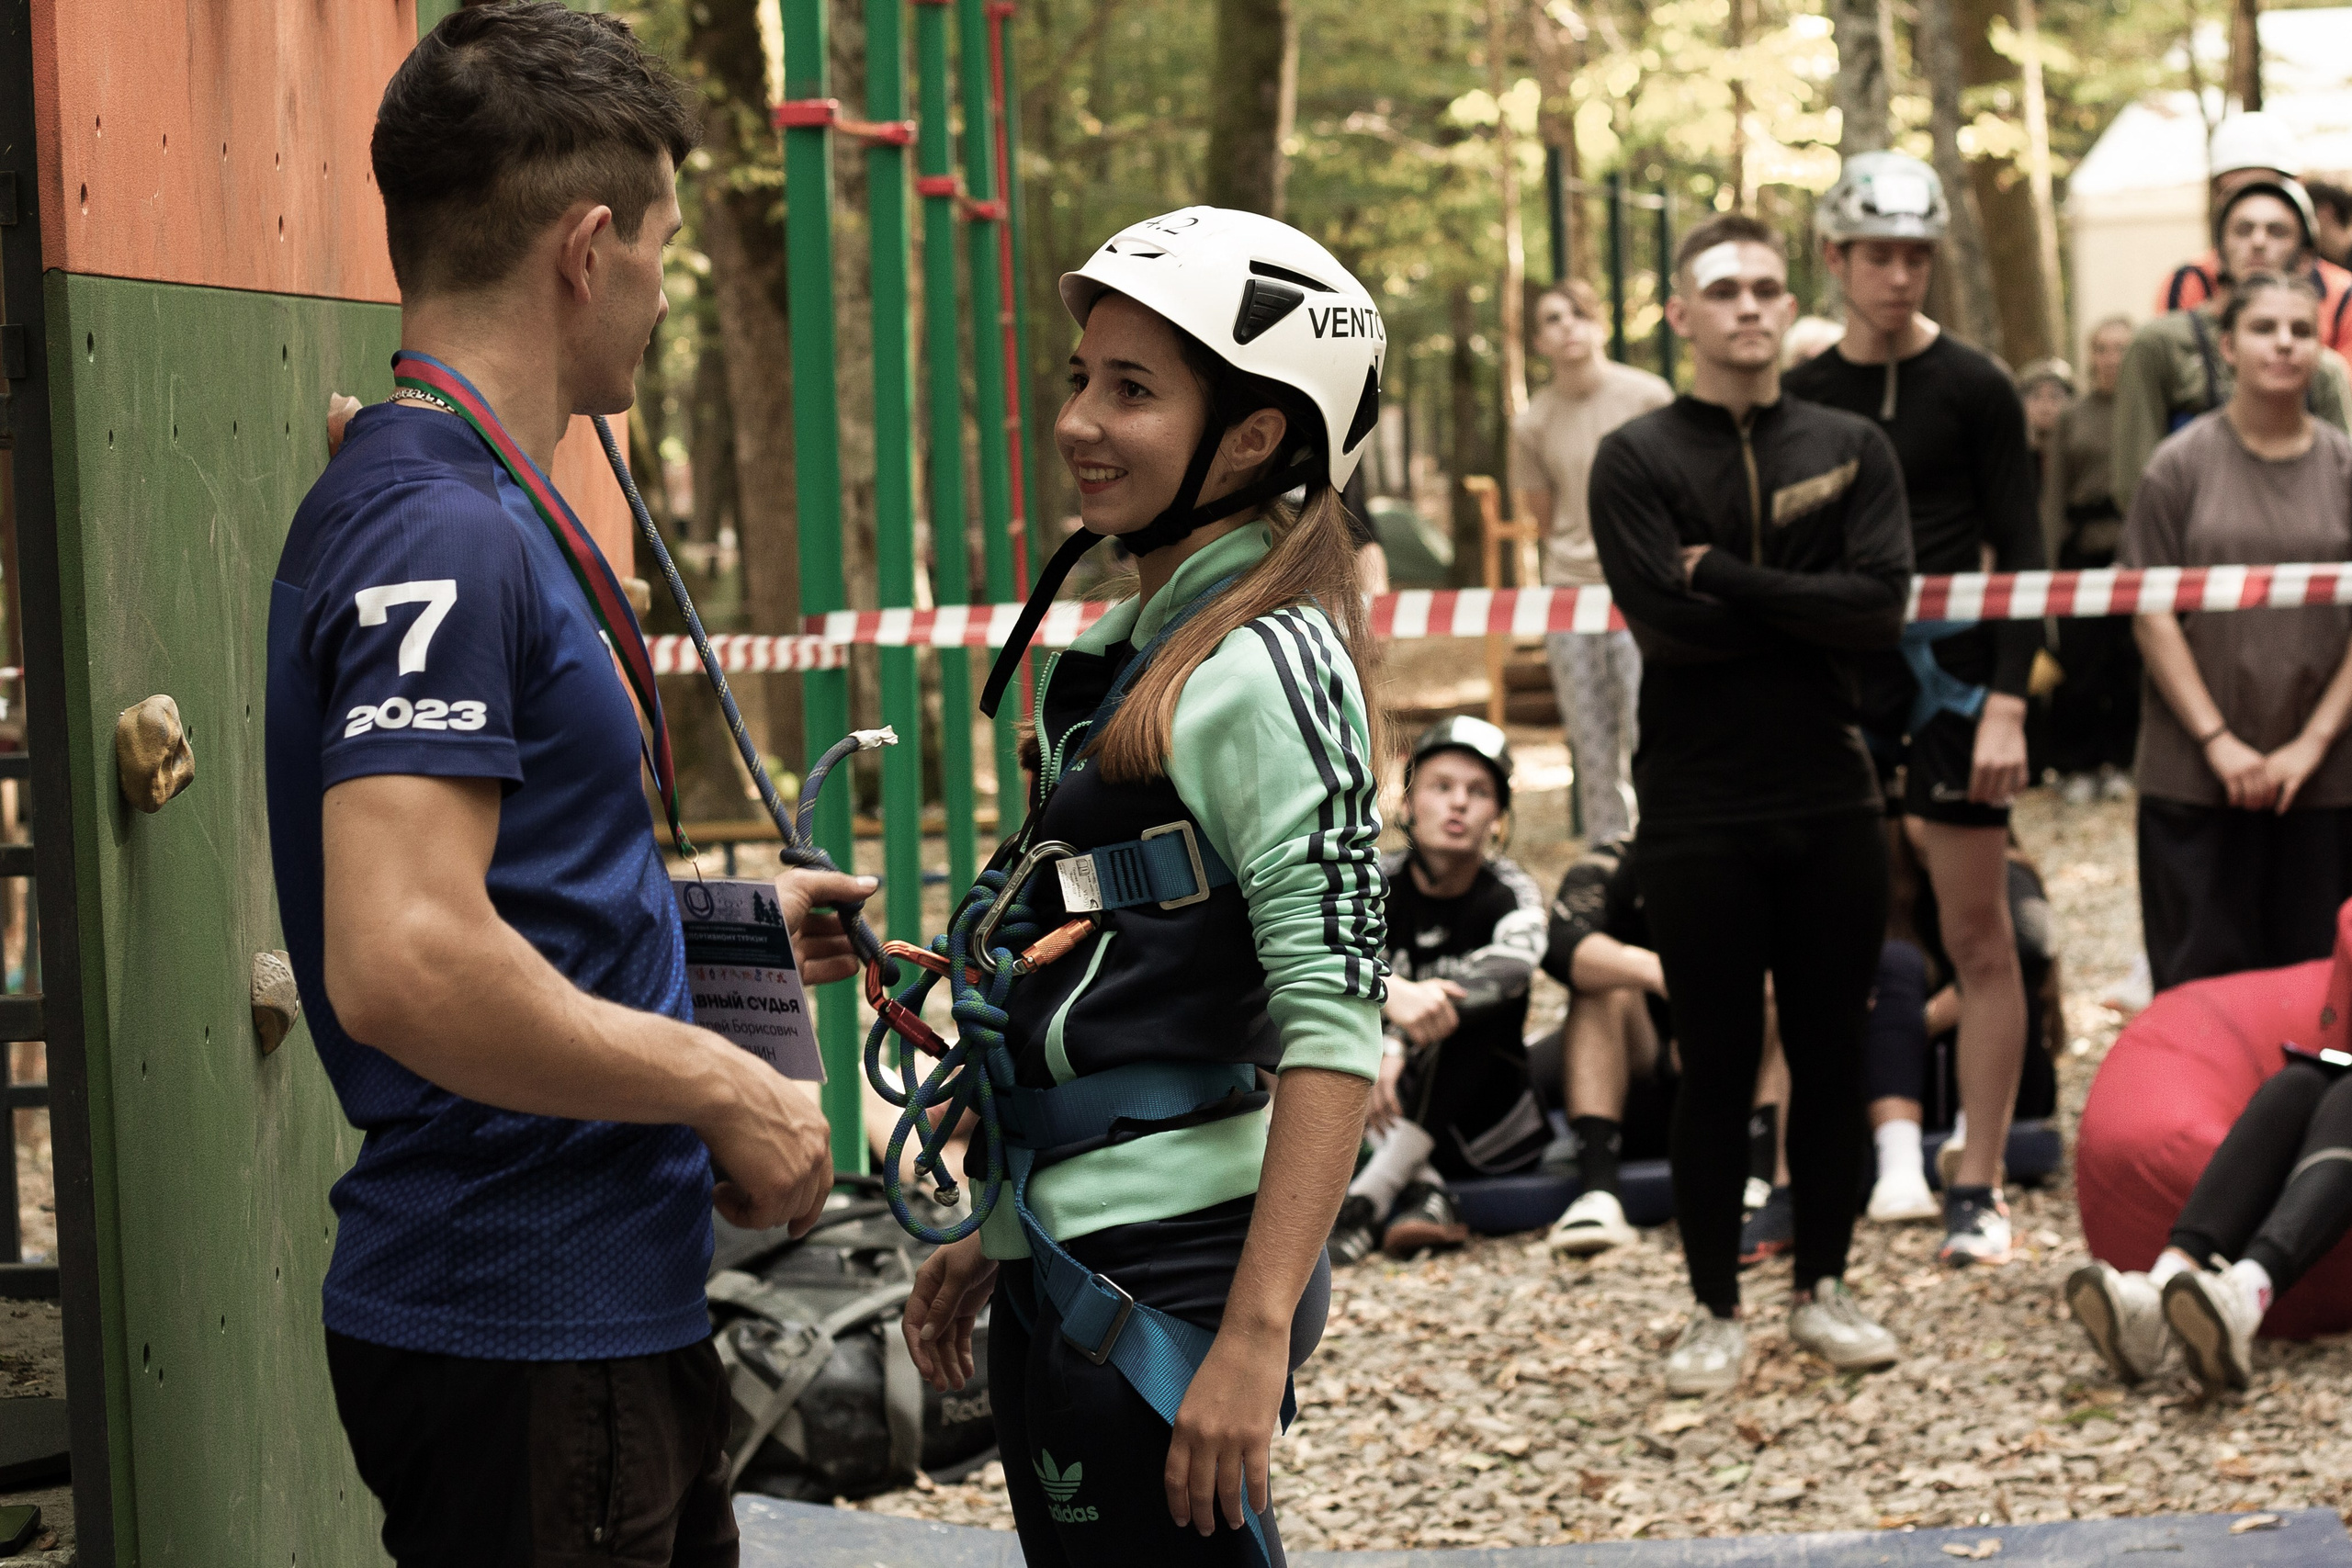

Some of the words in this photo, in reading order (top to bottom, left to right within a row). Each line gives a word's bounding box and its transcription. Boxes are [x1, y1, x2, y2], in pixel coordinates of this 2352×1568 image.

[1307, 307, 1384, 341] VENTO
[355, 579, 457, 676] 7
[344, 696, 487, 739] 2023
[747, 996, 800, 1014] СУДЬЯ
[731, 1019, 798, 1037] Борисович
